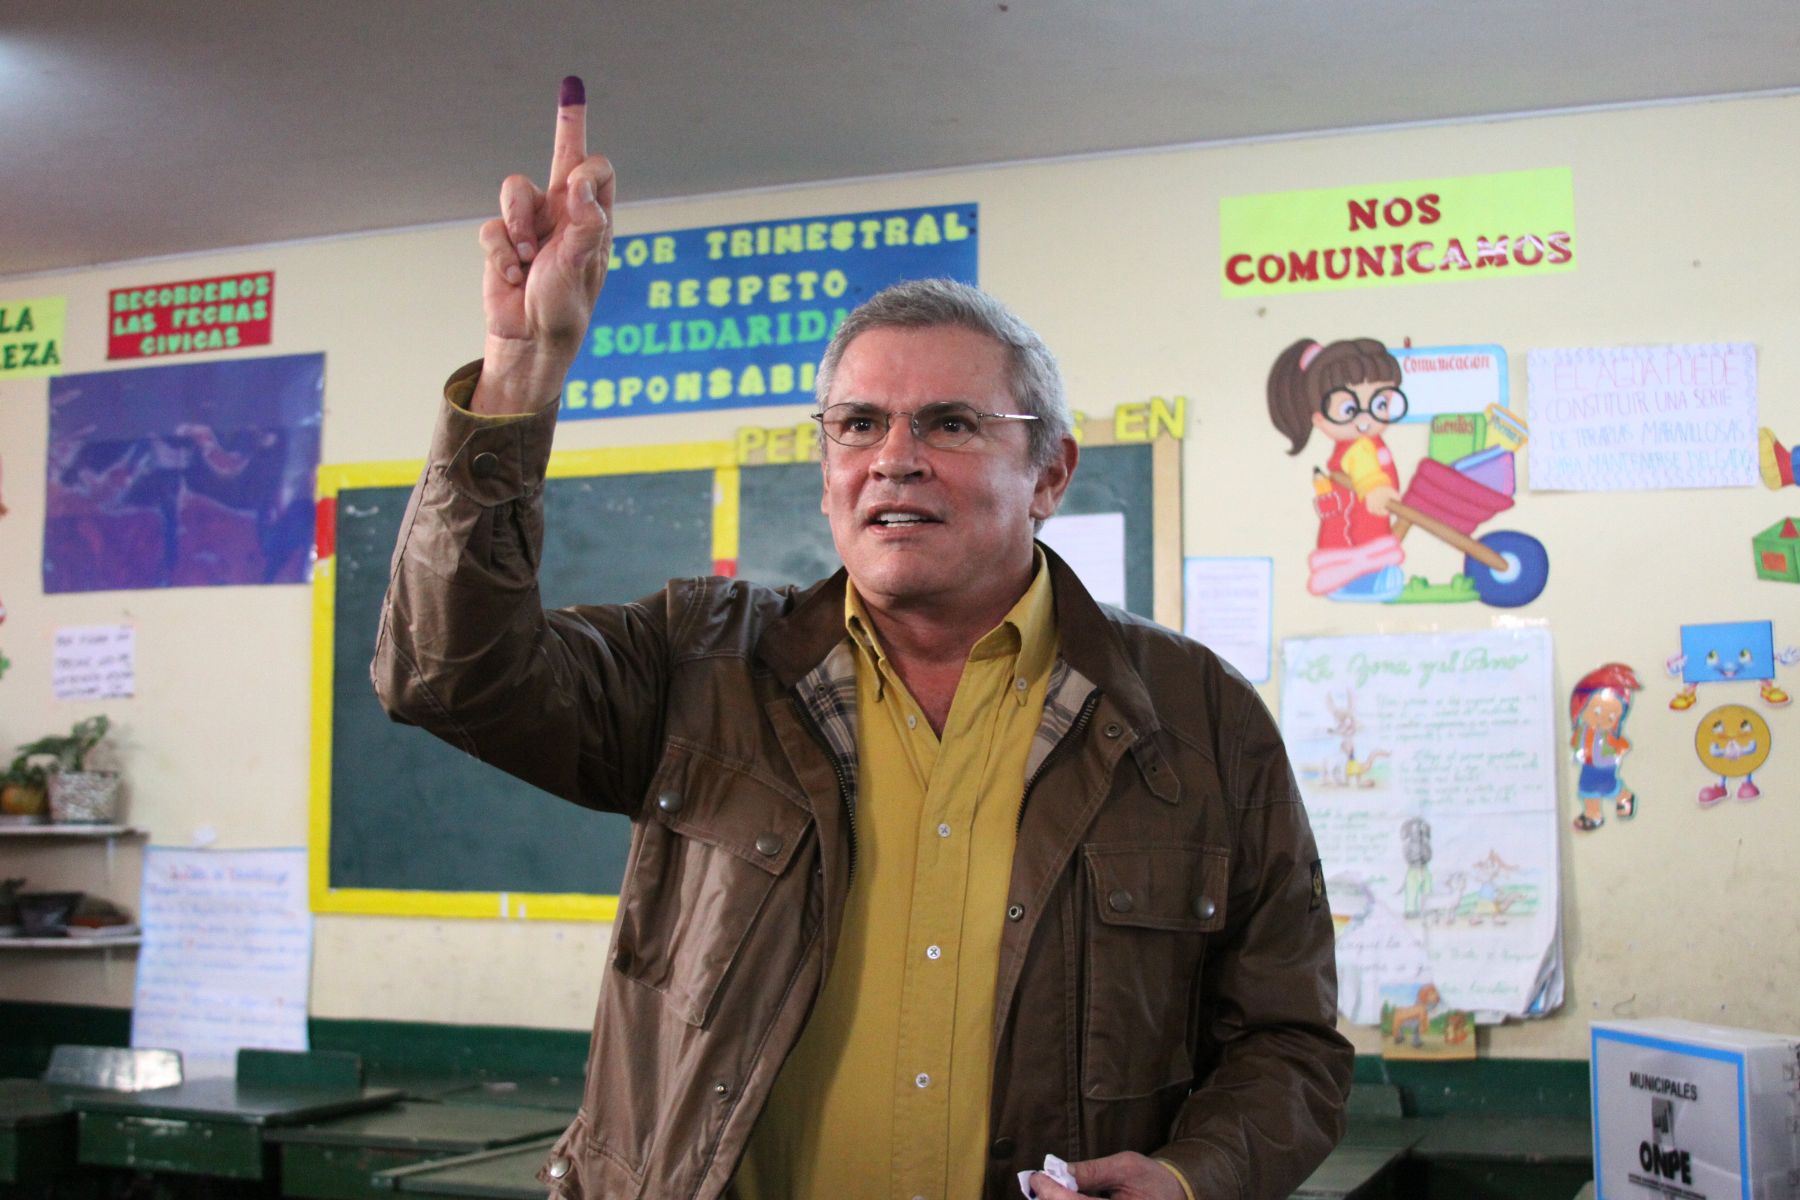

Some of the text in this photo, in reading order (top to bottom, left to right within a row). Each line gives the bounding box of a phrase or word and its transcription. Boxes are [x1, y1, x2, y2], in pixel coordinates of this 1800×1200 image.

[1347, 193, 1441, 231] NOS
[706, 211, 968, 260] TRIMESTRAL
[1225, 232, 1573, 285] COMUNICAMOS
[113, 275, 270, 313] RECORDEMOS
[648, 269, 848, 309] RESPETO
[113, 299, 267, 336] LAS FECHAS
[0, 339, 61, 370] EZA
[140, 326, 241, 355] CIVICAS
[559, 362, 816, 409] ESPONSABI
[1554, 362, 1588, 392] EL
[1665, 350, 1739, 387] PUEDE
[1115, 396, 1185, 441] EN
[1654, 390, 1688, 413] UNA
[1629, 1071, 1698, 1101] MUNICIPALES
[1639, 1140, 1692, 1186] ONPE
